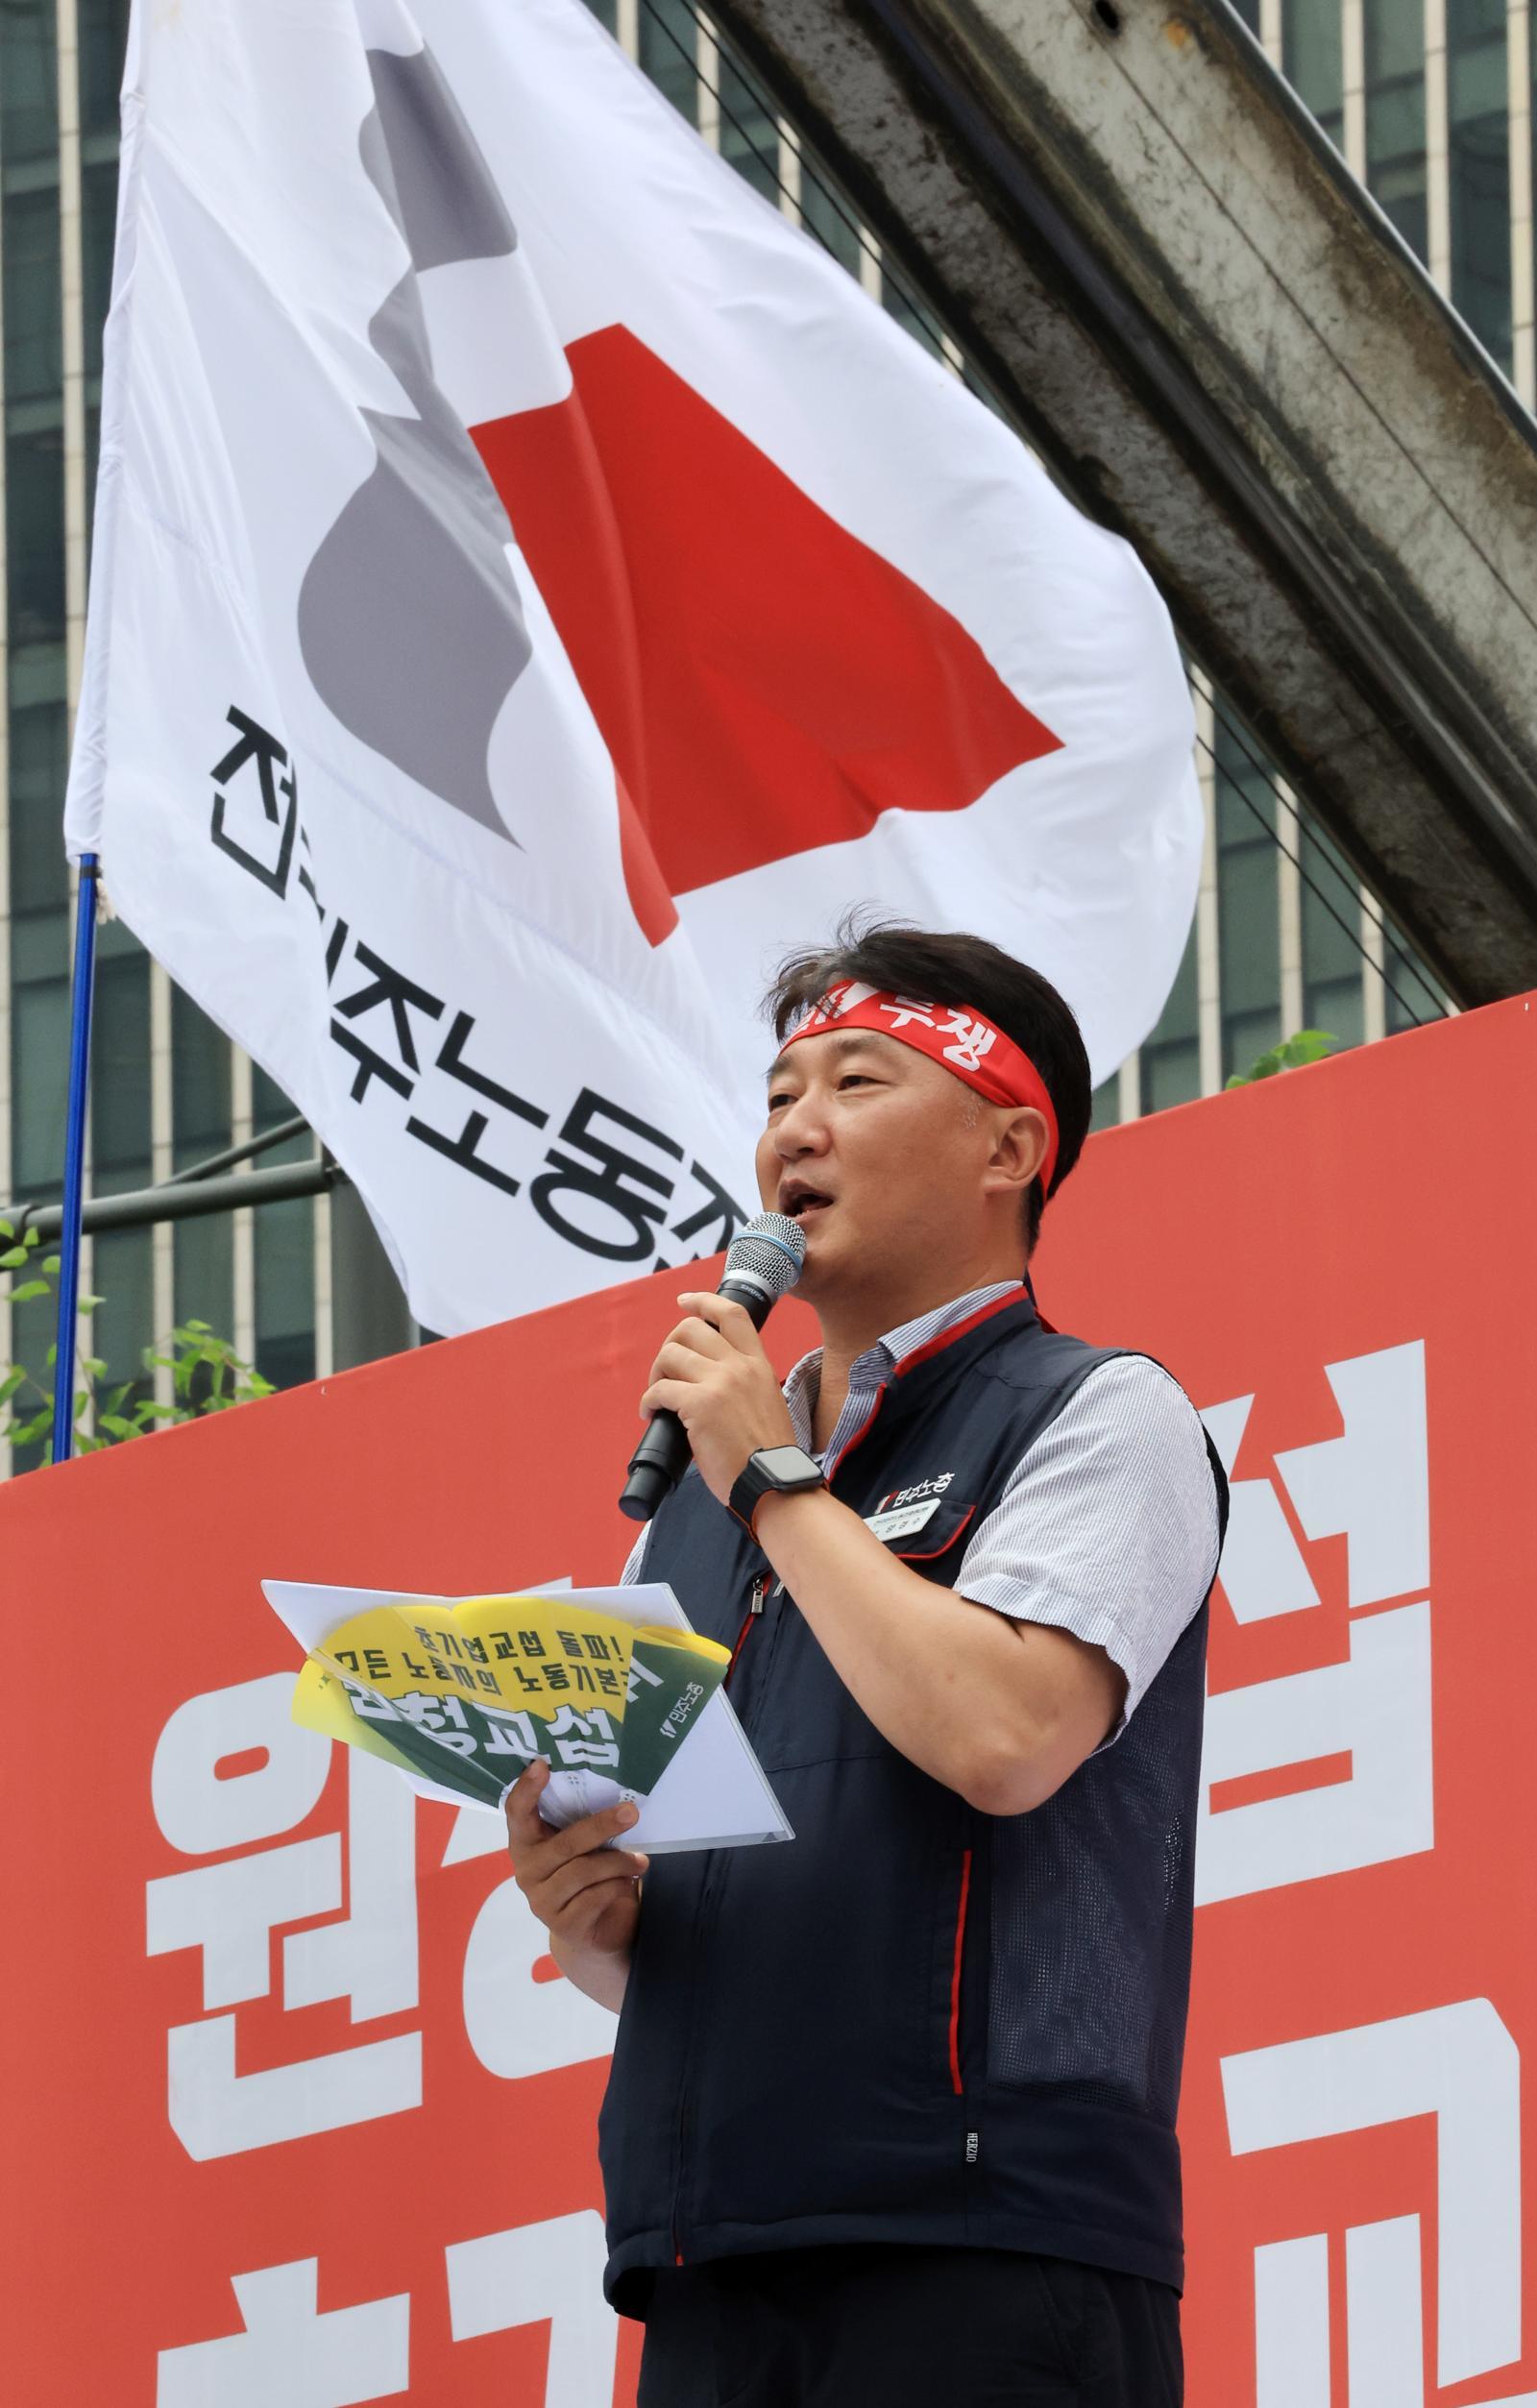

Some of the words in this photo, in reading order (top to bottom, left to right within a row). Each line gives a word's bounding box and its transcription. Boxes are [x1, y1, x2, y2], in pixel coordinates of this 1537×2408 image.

[414, 1626, 546, 1664] 초기업교섭
[556, 1630, 624, 1662] 돌파!
[402, 1652, 501, 1695] 노동자의
[513, 1664, 629, 1695] 노동기본
[669, 1682, 704, 1724] 민주노총
[966, 2132, 978, 2162] HERZIO
